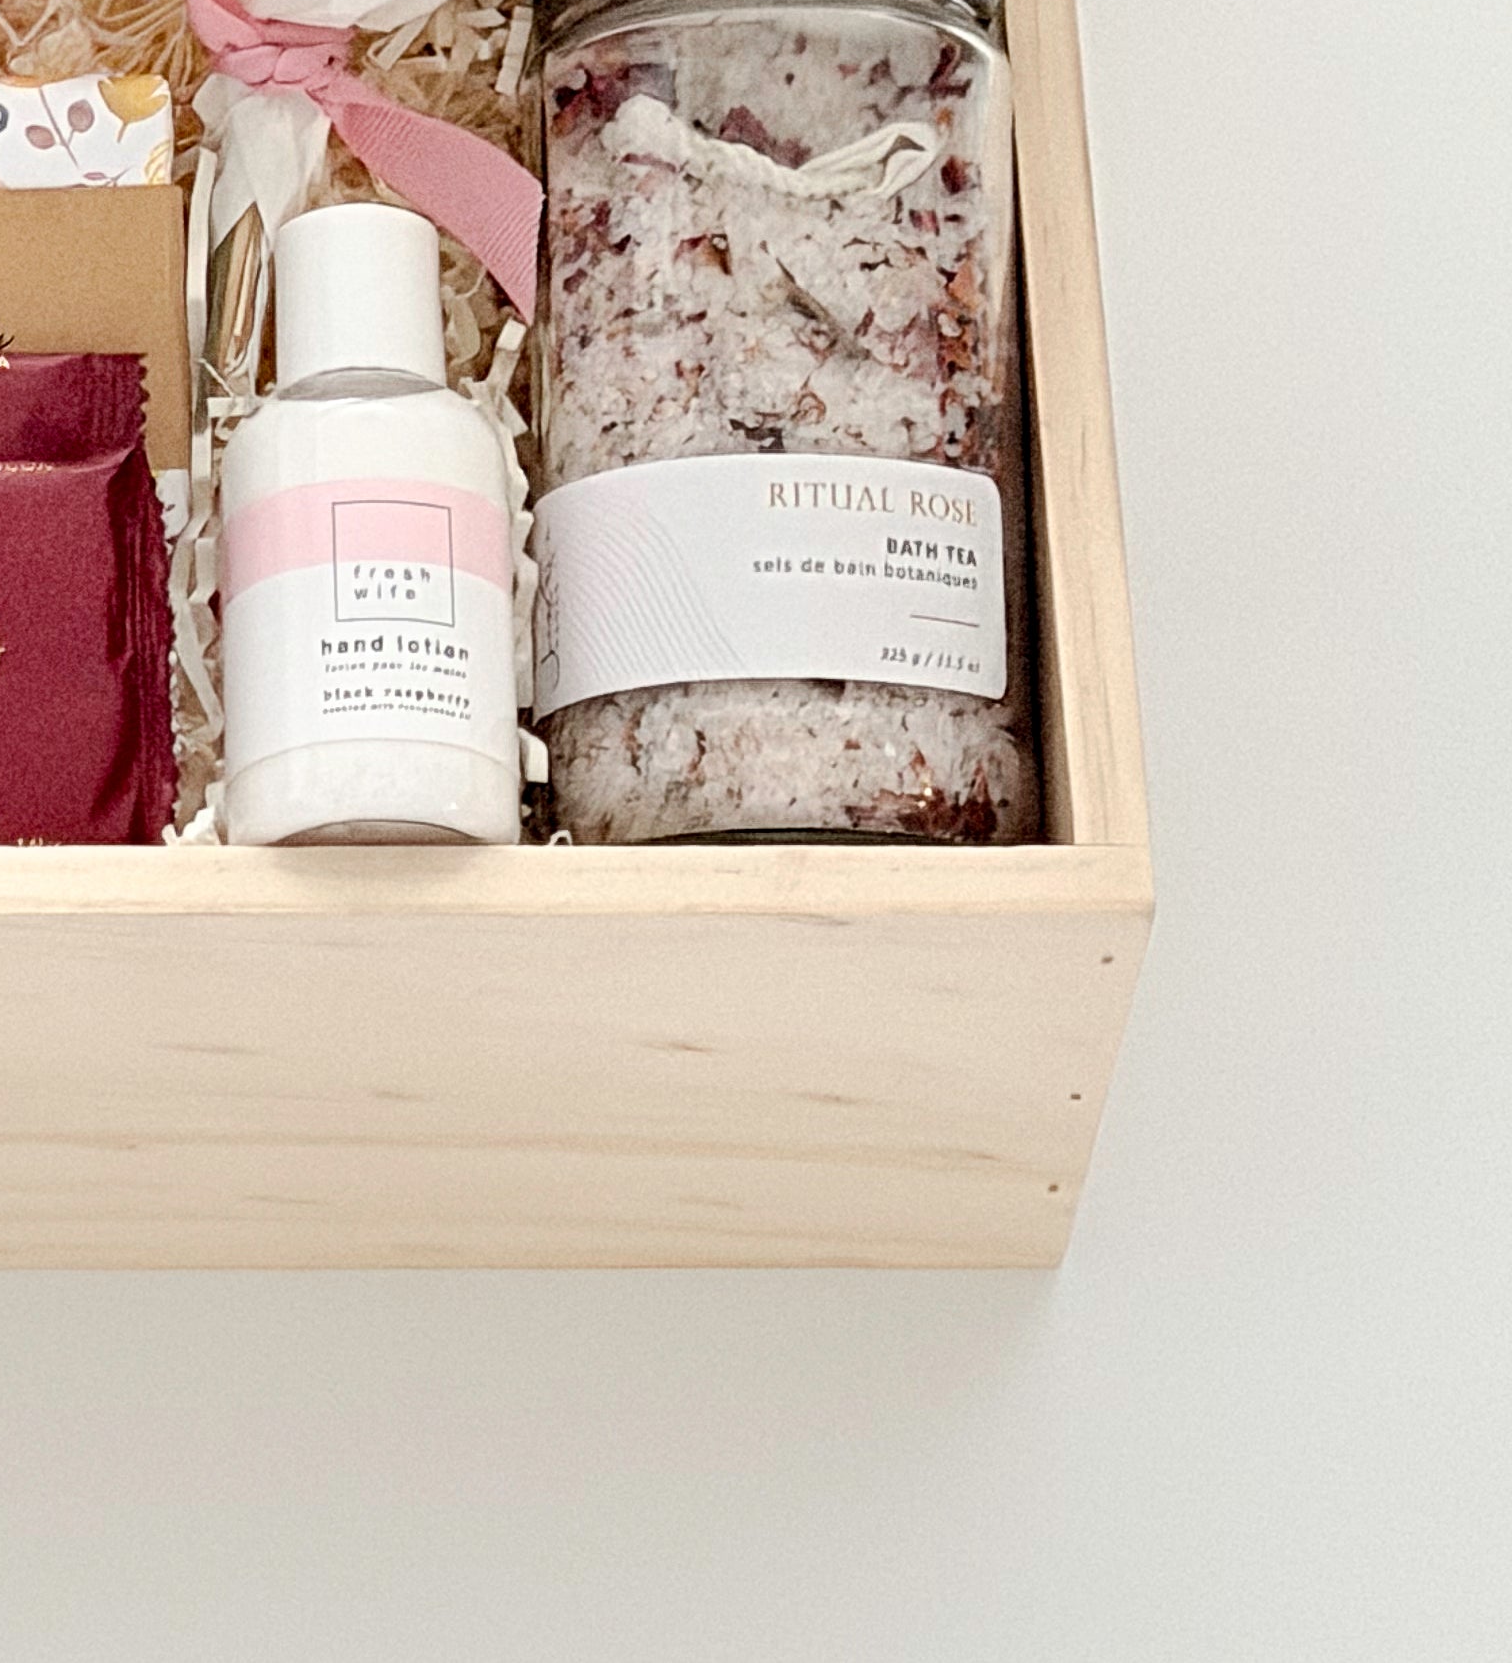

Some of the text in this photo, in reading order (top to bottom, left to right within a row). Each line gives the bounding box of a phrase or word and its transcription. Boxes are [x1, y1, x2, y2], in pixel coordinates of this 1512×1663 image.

[768, 482, 979, 528] RITUAL ROSE
[886, 537, 978, 567] BATH TEA
[353, 565, 431, 583] fresh
[753, 556, 979, 590] sels de bain botaniques
[354, 585, 416, 601] wife
[321, 634, 469, 661] hand lotion
[323, 687, 374, 702] black
